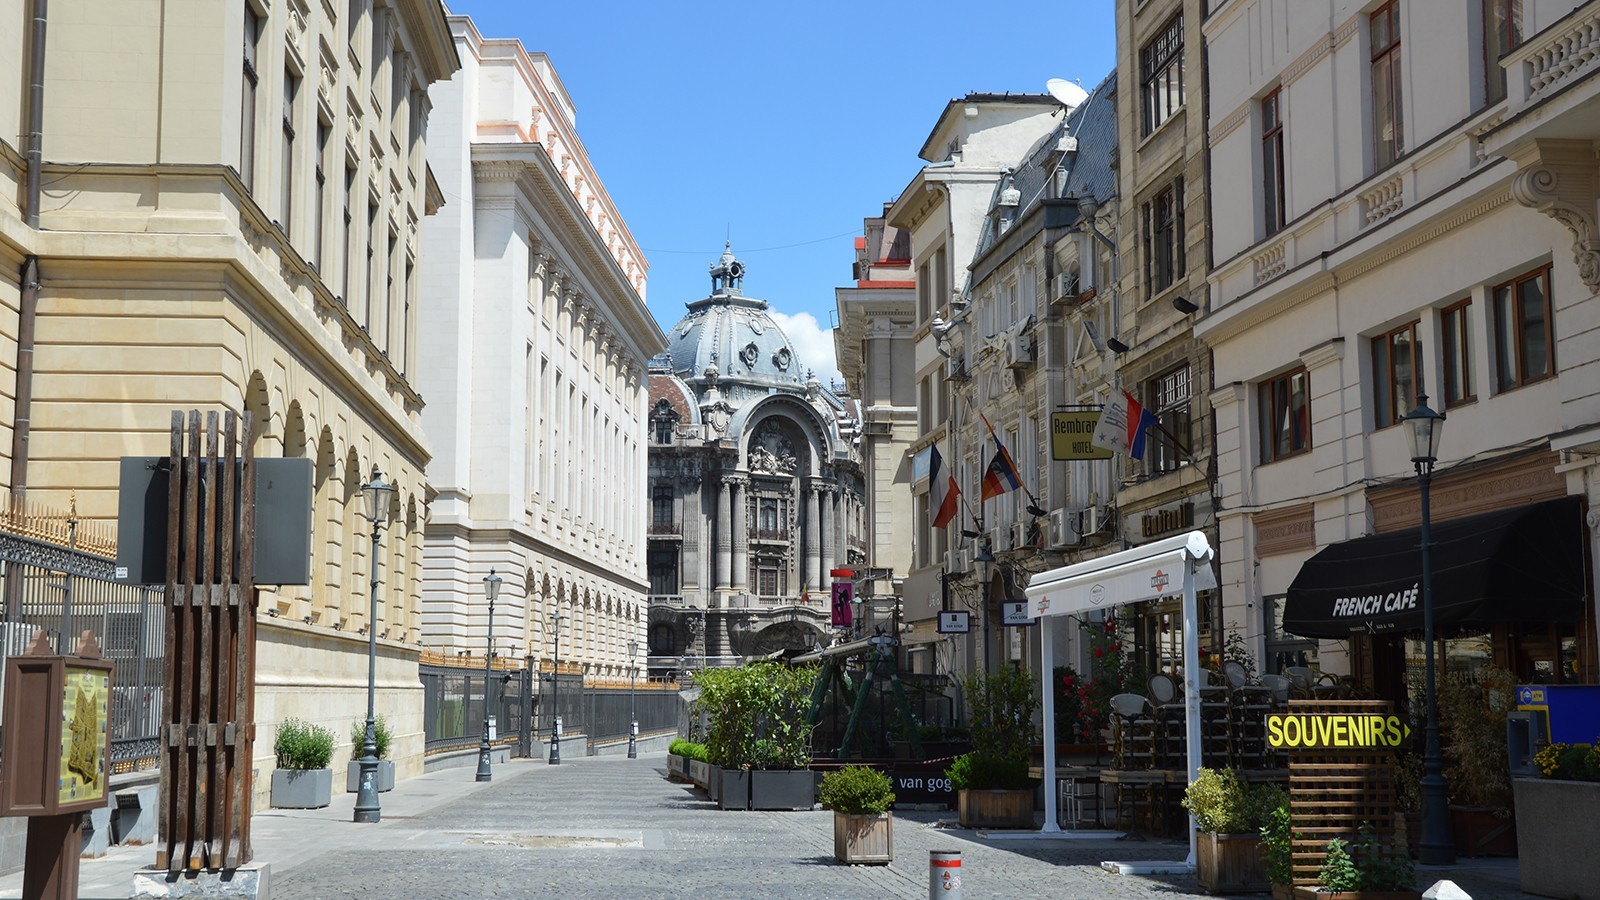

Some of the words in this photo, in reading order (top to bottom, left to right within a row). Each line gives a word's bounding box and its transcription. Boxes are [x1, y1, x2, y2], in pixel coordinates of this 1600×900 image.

[1054, 418, 1097, 434] Rembran
[1072, 441, 1094, 454] HOTEL
[1332, 594, 1383, 617] FRENCH
[1384, 582, 1419, 613] CAFÉ
[1267, 715, 1402, 747] SOUVENIRS
[900, 778, 923, 789] van
[927, 778, 952, 793] gog
